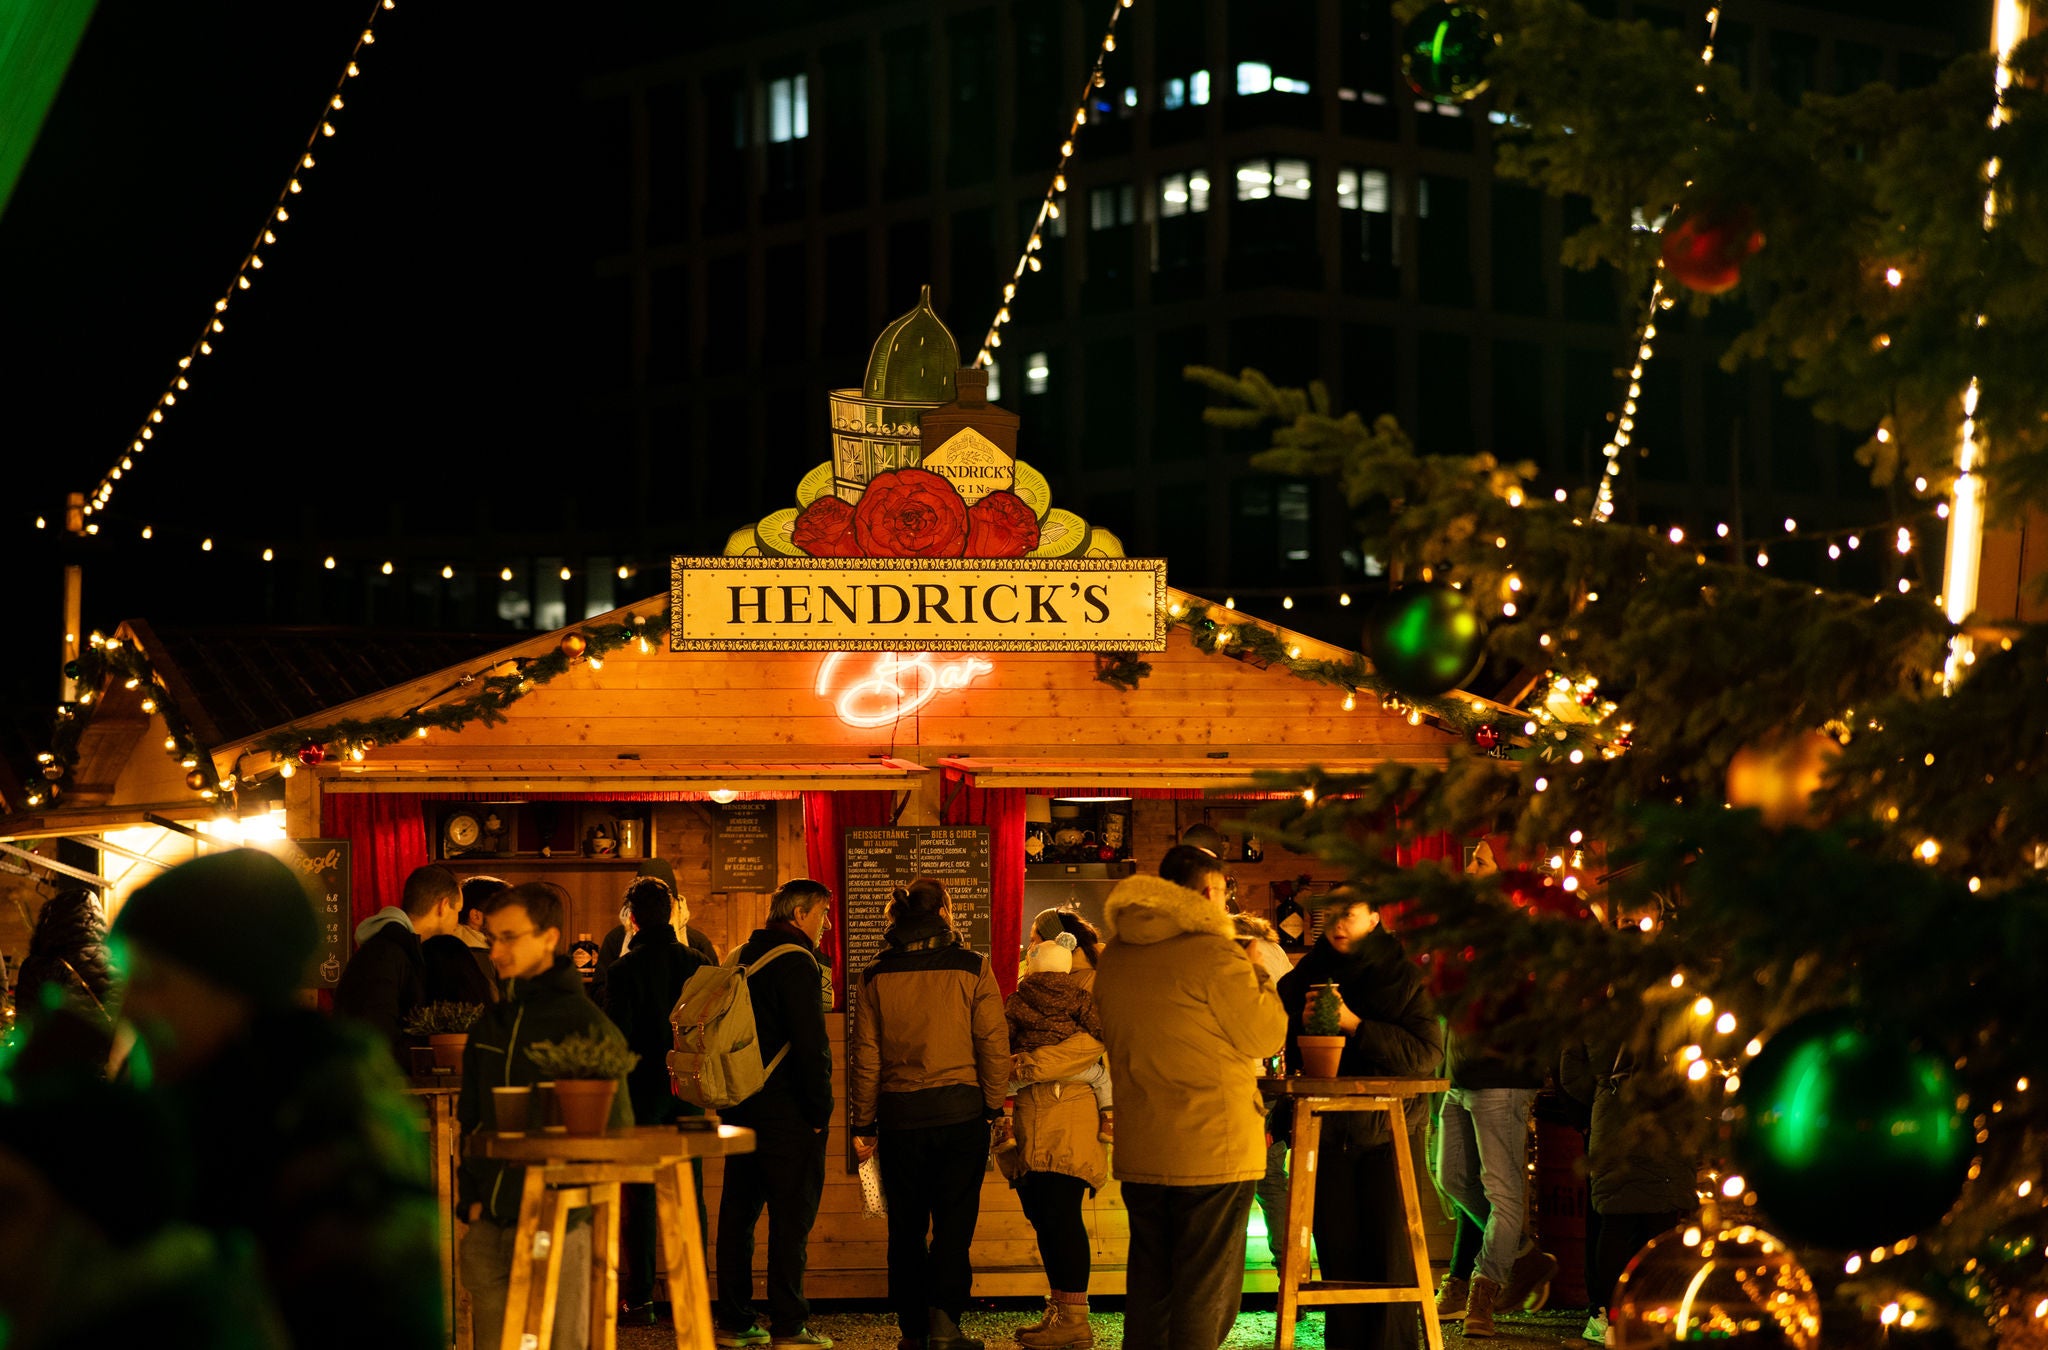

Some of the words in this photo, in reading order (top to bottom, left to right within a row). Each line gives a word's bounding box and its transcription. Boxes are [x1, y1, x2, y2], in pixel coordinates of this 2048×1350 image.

[957, 485, 984, 494] GIN
[727, 581, 1111, 625] HENDRICK'S
[819, 651, 992, 723] Bar
[852, 829, 910, 839] HEISSGETRÄNKE
[931, 830, 948, 839] BIER
[949, 830, 954, 838] &
[956, 830, 977, 839] CIDER
[937, 878, 978, 886] HAUMWEIN
[325, 893, 338, 902] 6.8
[325, 904, 338, 913] 6.3
[952, 902, 975, 911] SWEIN
